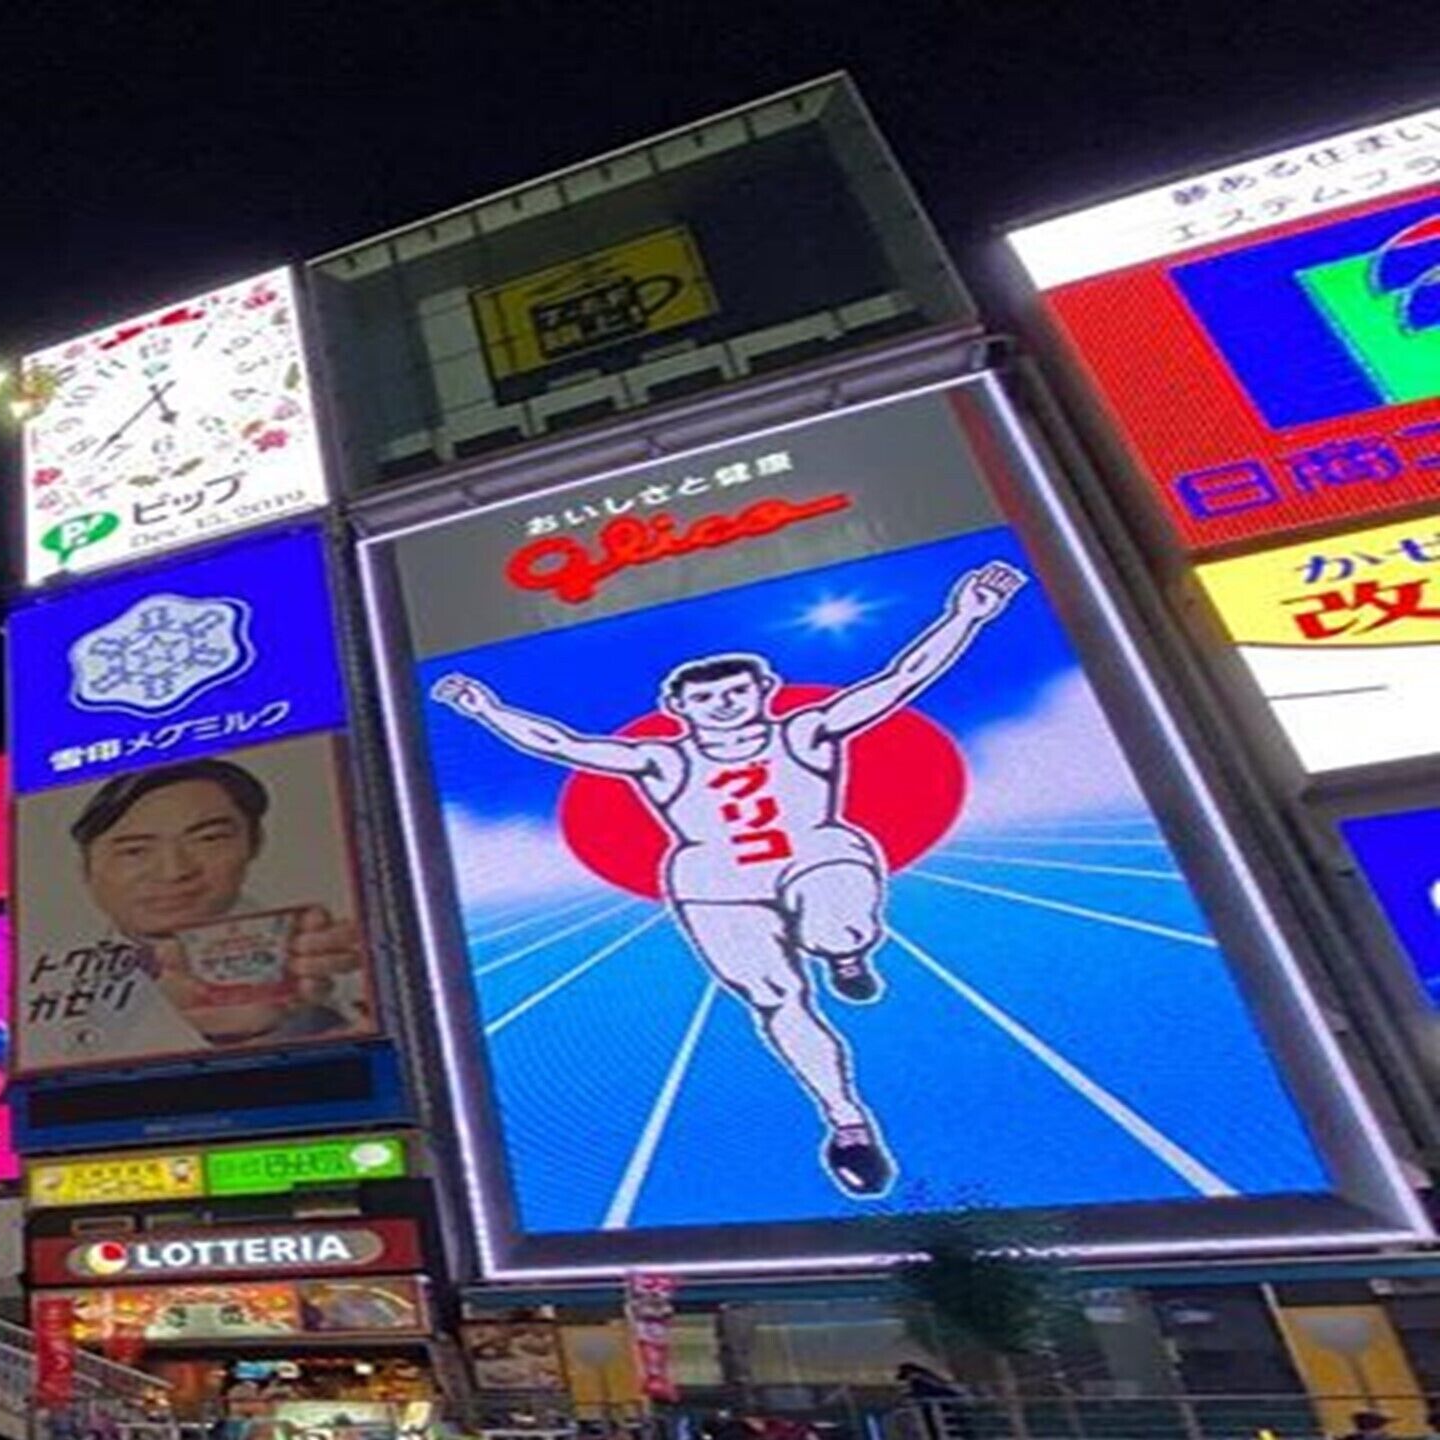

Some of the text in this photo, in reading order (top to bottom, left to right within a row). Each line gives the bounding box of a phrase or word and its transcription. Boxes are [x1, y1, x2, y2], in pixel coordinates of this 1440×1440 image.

[527, 452, 794, 536] おいしさと健康
[48, 700, 292, 773] 雪印メグミルク
[707, 758, 794, 866] グリコ
[137, 1234, 352, 1268] LOTTERIA
